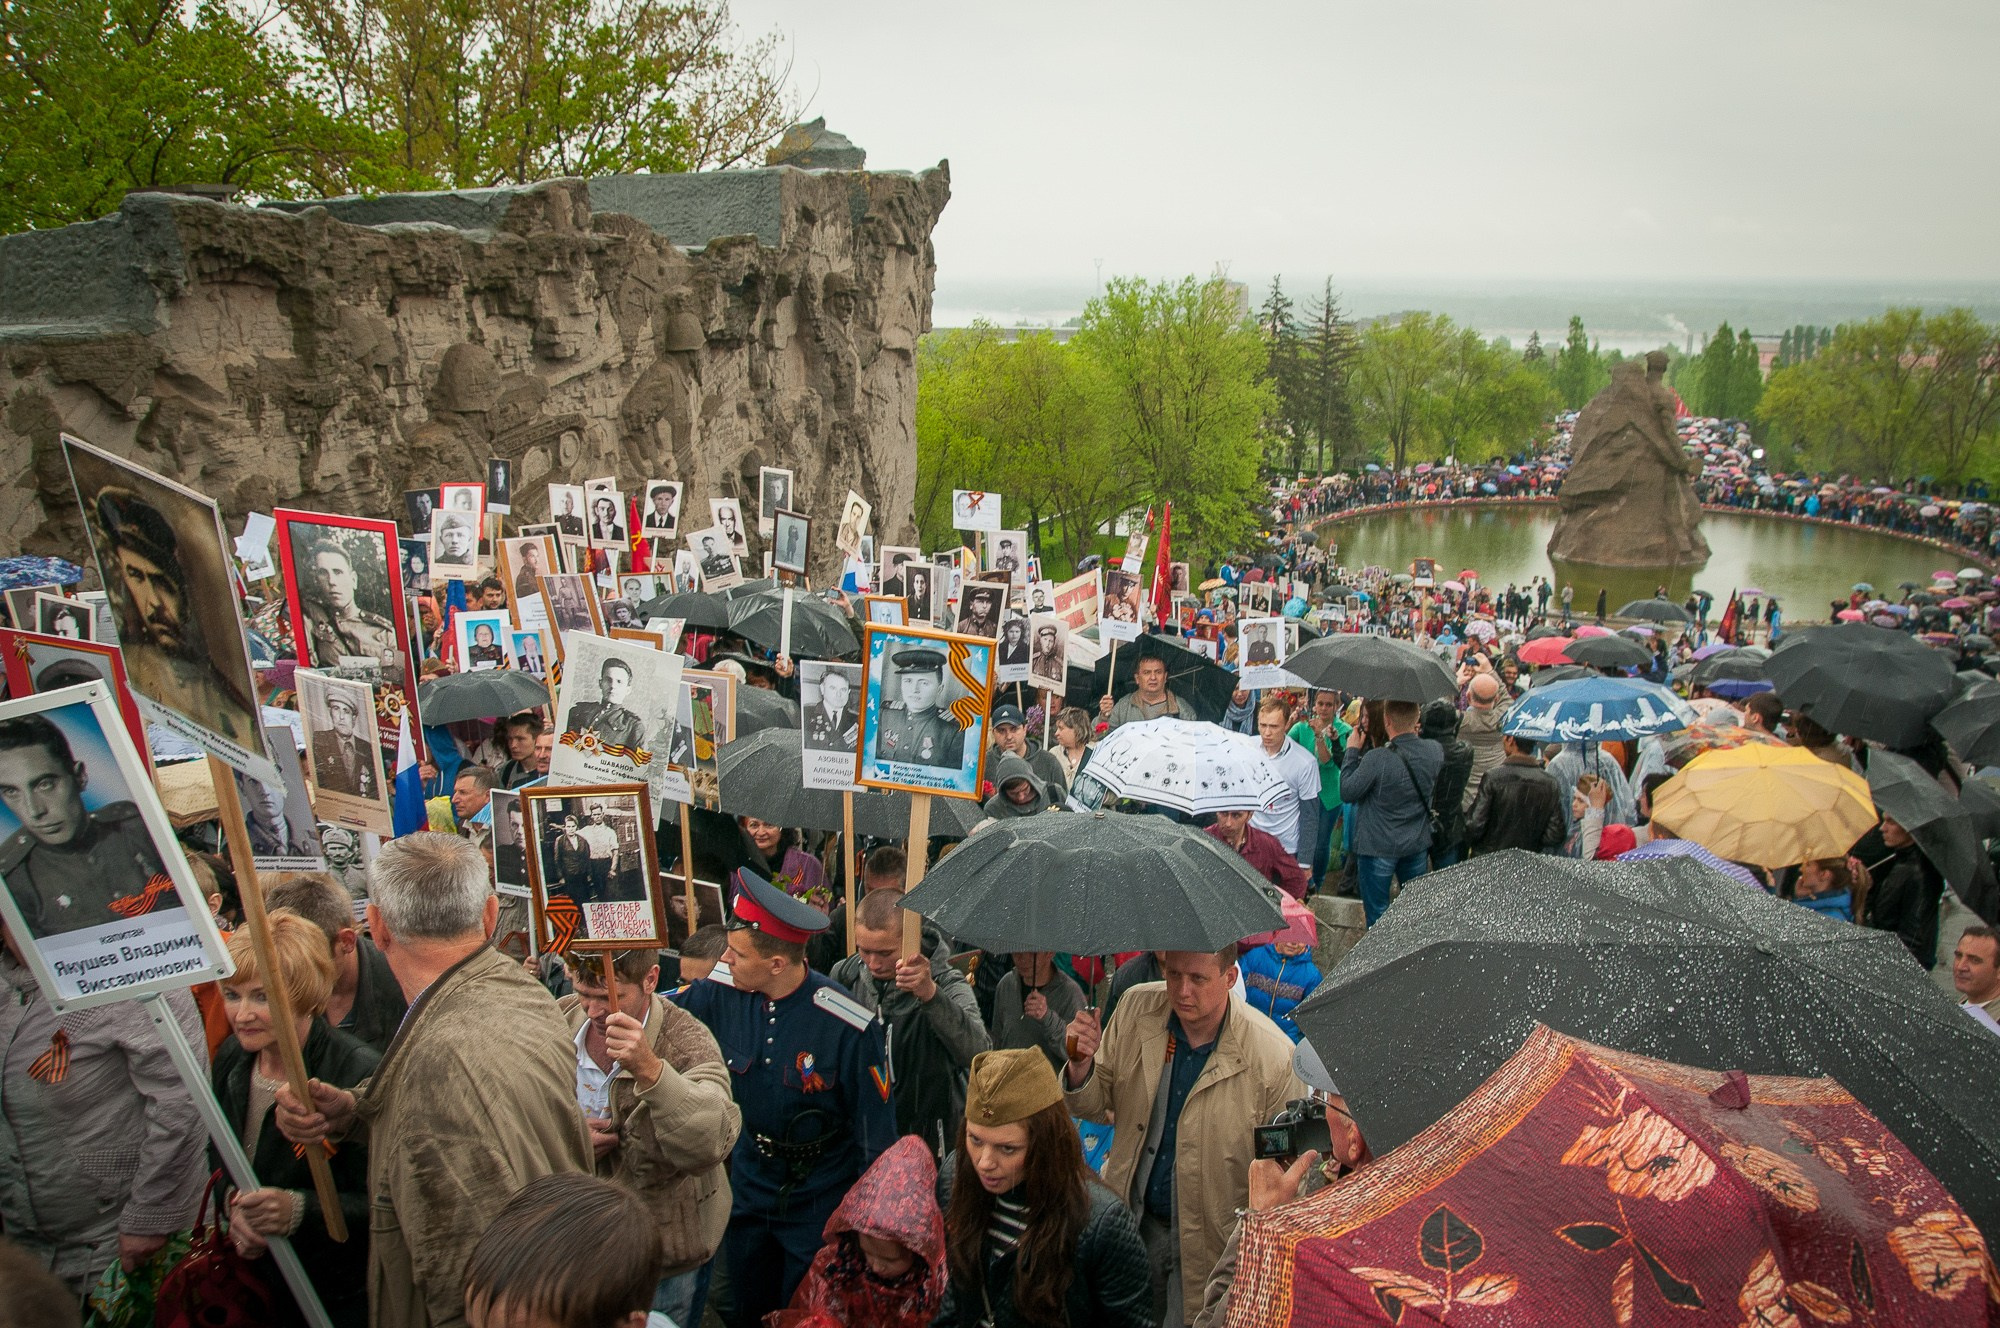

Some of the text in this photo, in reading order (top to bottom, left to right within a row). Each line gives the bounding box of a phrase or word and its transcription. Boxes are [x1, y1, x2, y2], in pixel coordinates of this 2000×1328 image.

[818, 755, 849, 764] АЗОВЦЕВ
[583, 762, 610, 773] Василий
[600, 759, 634, 773] ШАВАНОВ
[813, 766, 854, 777] АЛЕКСАНДР
[590, 902, 641, 912] САВЕЛЬЕВ
[591, 911, 638, 921] ДМИТРИЙ
[592, 919, 651, 929] ВАСИЛЬЕВИЧ
[100, 927, 145, 945] капитан
[54, 934, 203, 977] Якушев Владимир
[77, 957, 203, 994] Виссарионович
